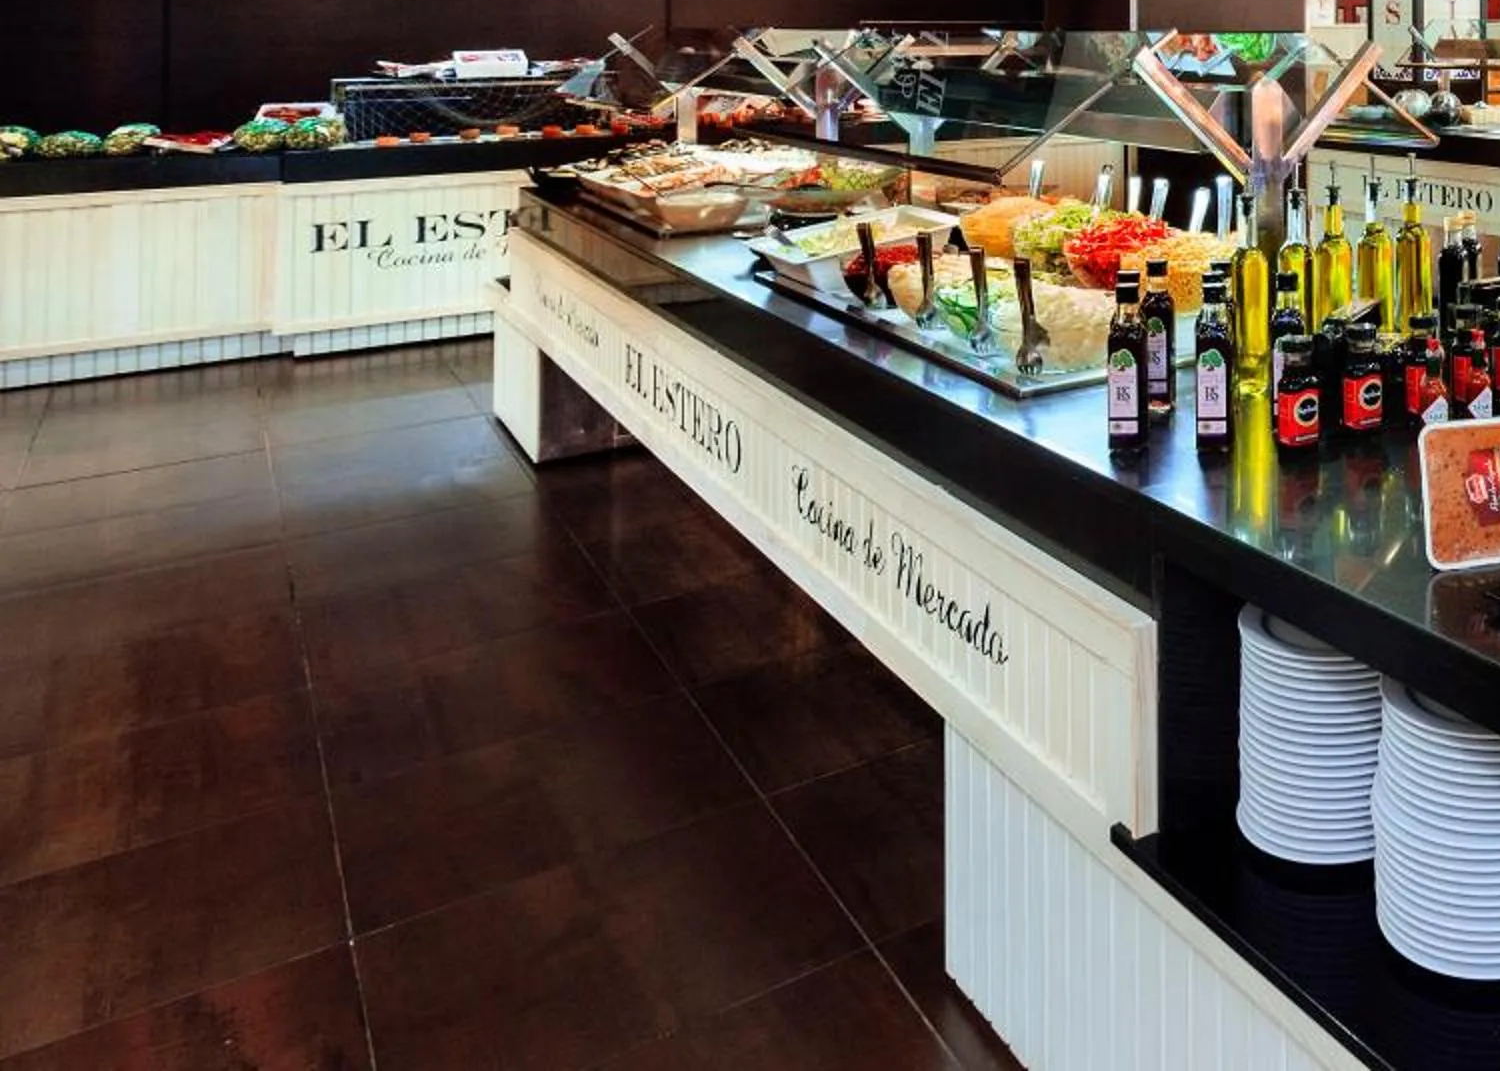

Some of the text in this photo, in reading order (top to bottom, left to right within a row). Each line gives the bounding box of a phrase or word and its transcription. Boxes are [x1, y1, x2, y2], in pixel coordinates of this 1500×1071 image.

[310, 219, 392, 253] EL
[367, 248, 454, 270] Cocina
[463, 242, 486, 260] de
[624, 342, 742, 475] EL ESTERO
[792, 463, 1009, 666] Cocina de Mercado
